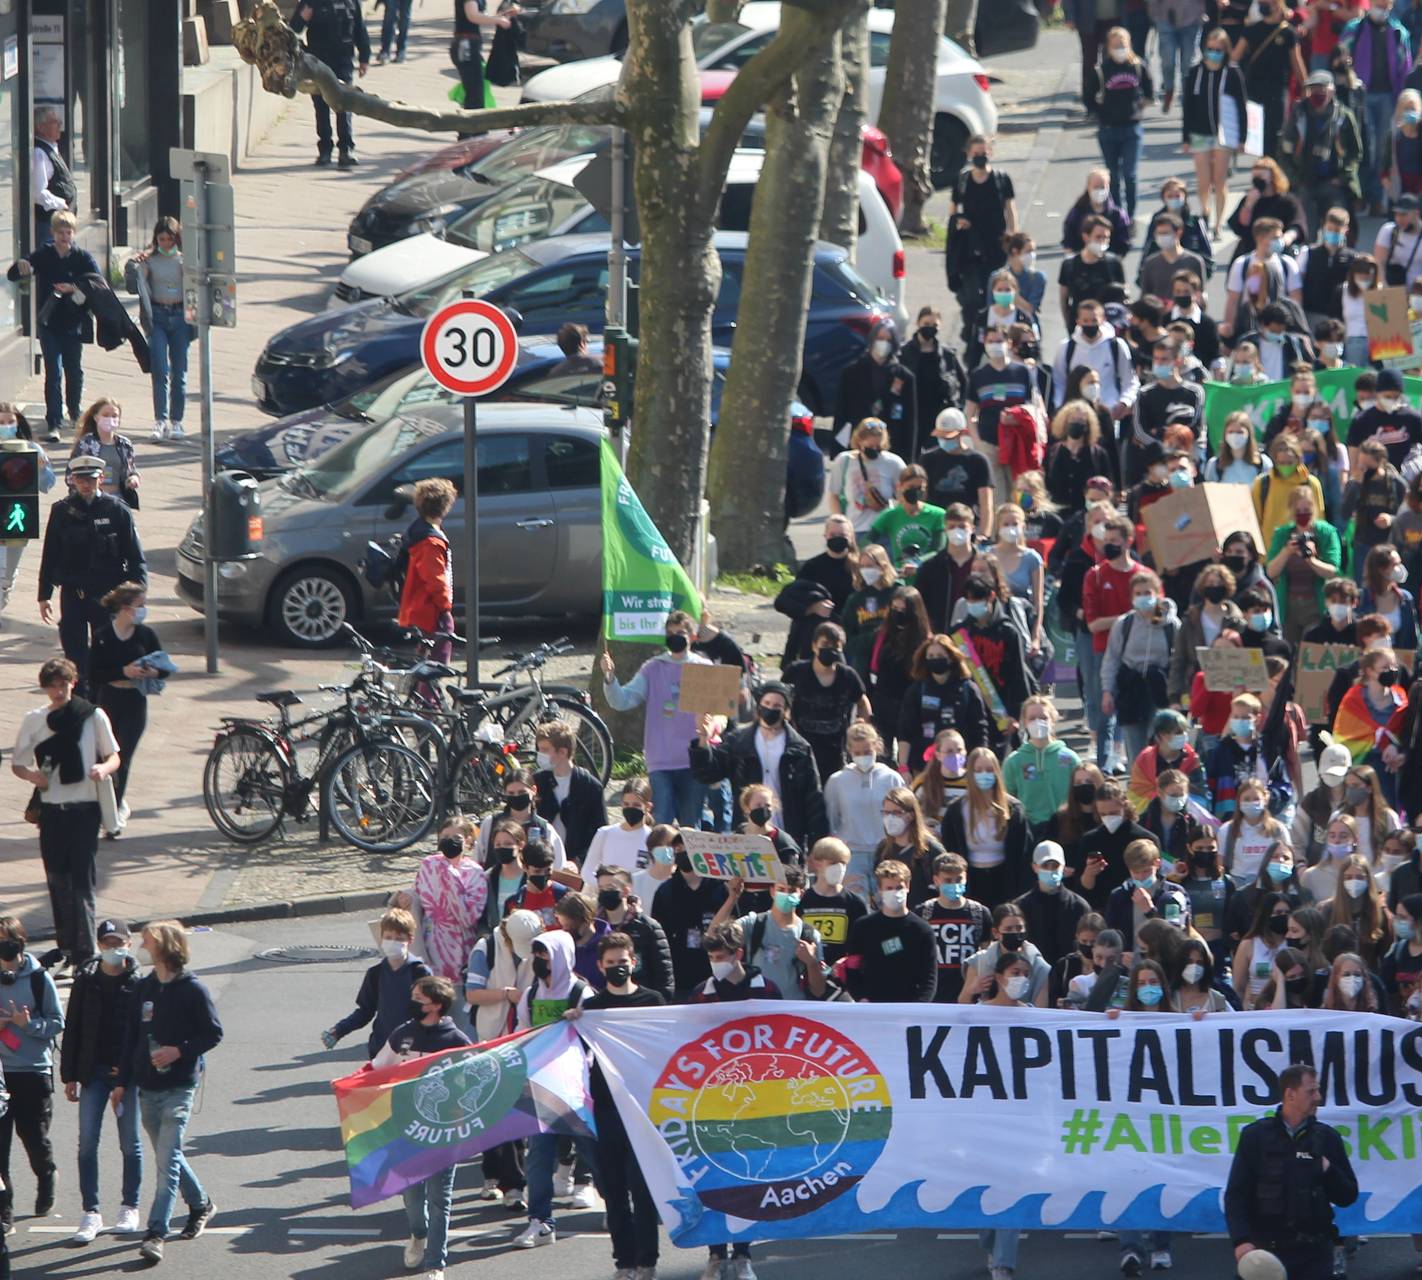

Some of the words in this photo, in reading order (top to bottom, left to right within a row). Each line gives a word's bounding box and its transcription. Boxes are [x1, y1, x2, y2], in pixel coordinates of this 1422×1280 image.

[444, 327, 495, 368] 30
[621, 595, 645, 609] Wir
[619, 617, 636, 630] bis
[640, 616, 658, 630] Ihr
[693, 852, 777, 881] GERETTET
[813, 919, 835, 938] 73
[660, 1055, 710, 1183] FRIDAYS
[701, 1024, 776, 1061] FOR
[784, 1026, 883, 1113] FUTURE
[760, 1160, 853, 1209] Aachen
